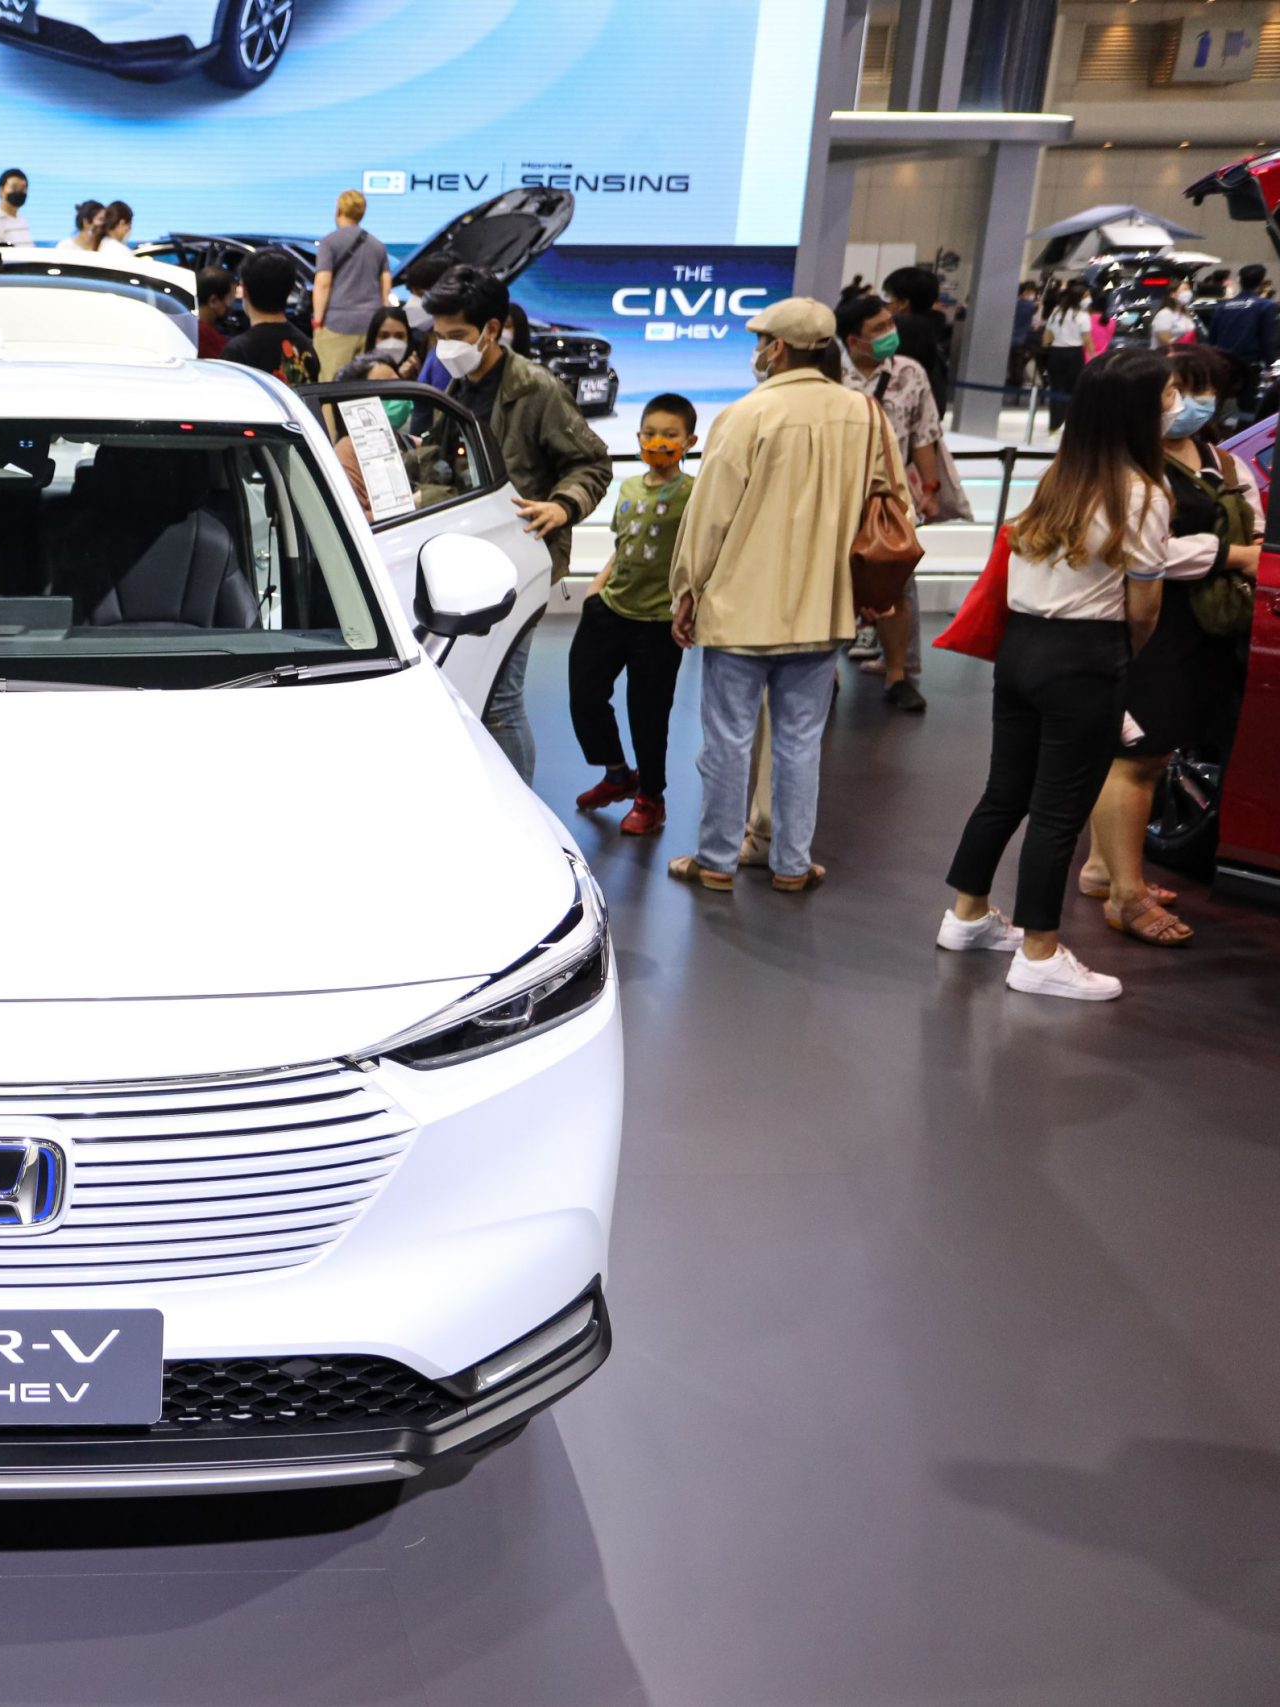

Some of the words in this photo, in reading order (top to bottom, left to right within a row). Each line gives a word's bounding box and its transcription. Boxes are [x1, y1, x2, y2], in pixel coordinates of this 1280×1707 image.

[521, 174, 690, 192] SENSING
[673, 265, 713, 282] THE
[612, 287, 767, 316] CIVIC
